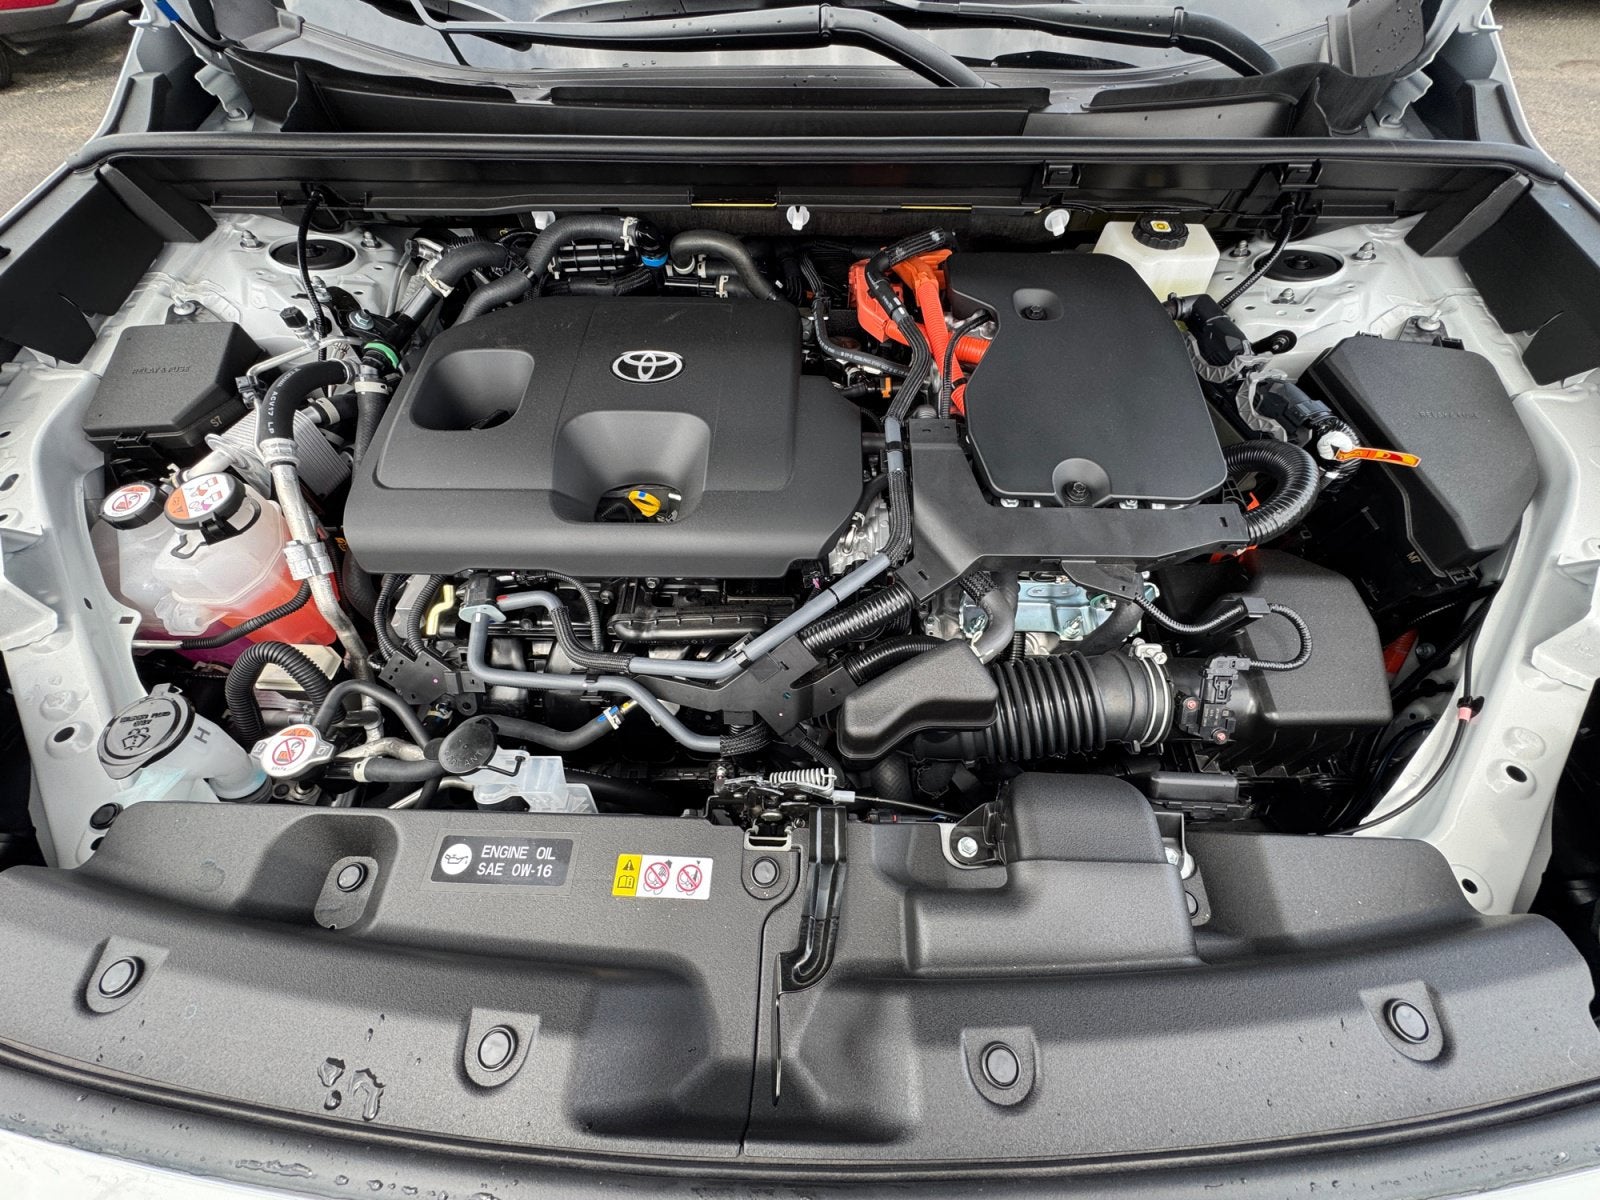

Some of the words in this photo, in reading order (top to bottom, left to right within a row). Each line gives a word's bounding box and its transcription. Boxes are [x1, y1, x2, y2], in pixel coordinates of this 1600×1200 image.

[210, 415, 223, 428] S7
[1406, 551, 1422, 564] M7
[481, 845, 530, 859] ENGINE
[536, 846, 556, 860] OIL
[476, 862, 505, 876] SAE
[511, 863, 553, 878] 0W-16
